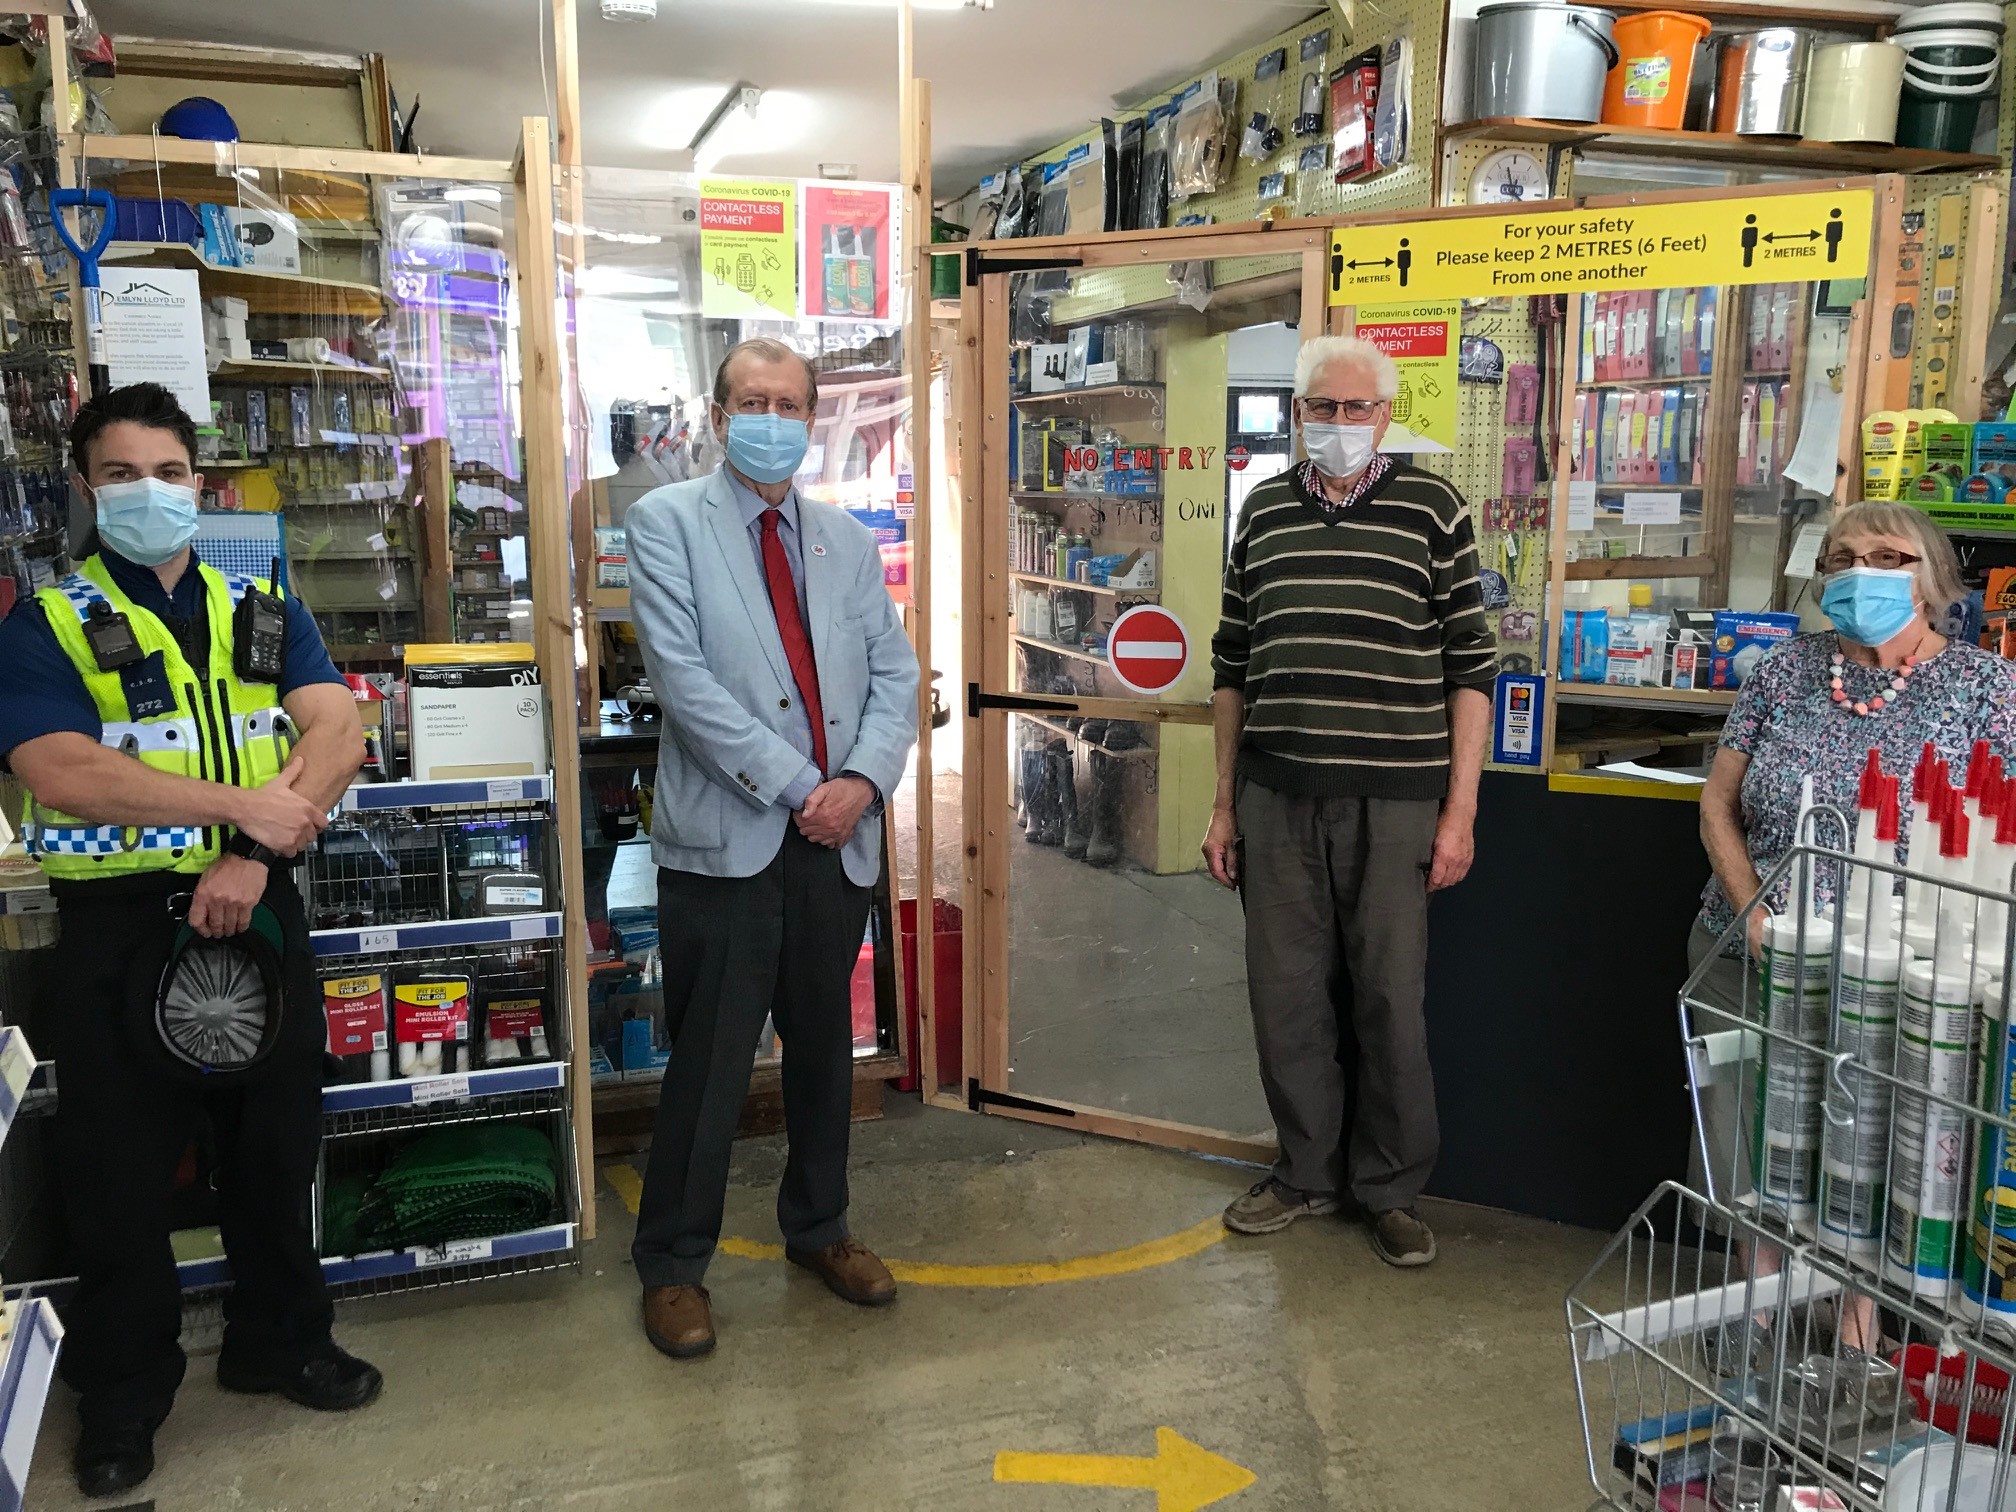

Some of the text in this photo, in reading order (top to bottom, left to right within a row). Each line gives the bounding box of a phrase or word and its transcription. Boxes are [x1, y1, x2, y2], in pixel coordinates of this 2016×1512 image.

[704, 185, 790, 197] Coronavirus COVID-19
[703, 201, 780, 215] CONTACTLESS
[703, 214, 753, 226] PAYMENT
[1504, 217, 1634, 240] For your safety
[1436, 234, 1707, 267] Please keep 2 METRES (6 Feet)
[1763, 246, 1817, 259] 2 METRES
[1349, 274, 1391, 284] 2 METRES
[1492, 262, 1647, 286] From one another
[116, 295, 142, 303] EMLYN
[144, 296, 170, 304] LLOYD
[171, 297, 186, 305] LTD
[1360, 306, 1457, 319] Coronavirus COVID-19
[1359, 325, 1444, 339] CONTACTLESS
[1372, 340, 1413, 351] YMENT
[1402, 361, 1439, 369] contactless
[1063, 446, 1217, 473] NO ENTRY
[1738, 626, 1791, 636] EMERGENCY
[418, 671, 463, 680] essentials
[510, 666, 539, 687] DIY
[136, 699, 164, 713] 272
[420, 703, 457, 711] SANDPAPER
[340, 987, 353, 995] THE
[345, 1005, 369, 1013] ROLLER
[415, 1010, 449, 1018] EMULSION
[429, 1080, 450, 1089] Roller
[430, 1091, 451, 1099] Roller
[452, 1087, 468, 1095] Sets
